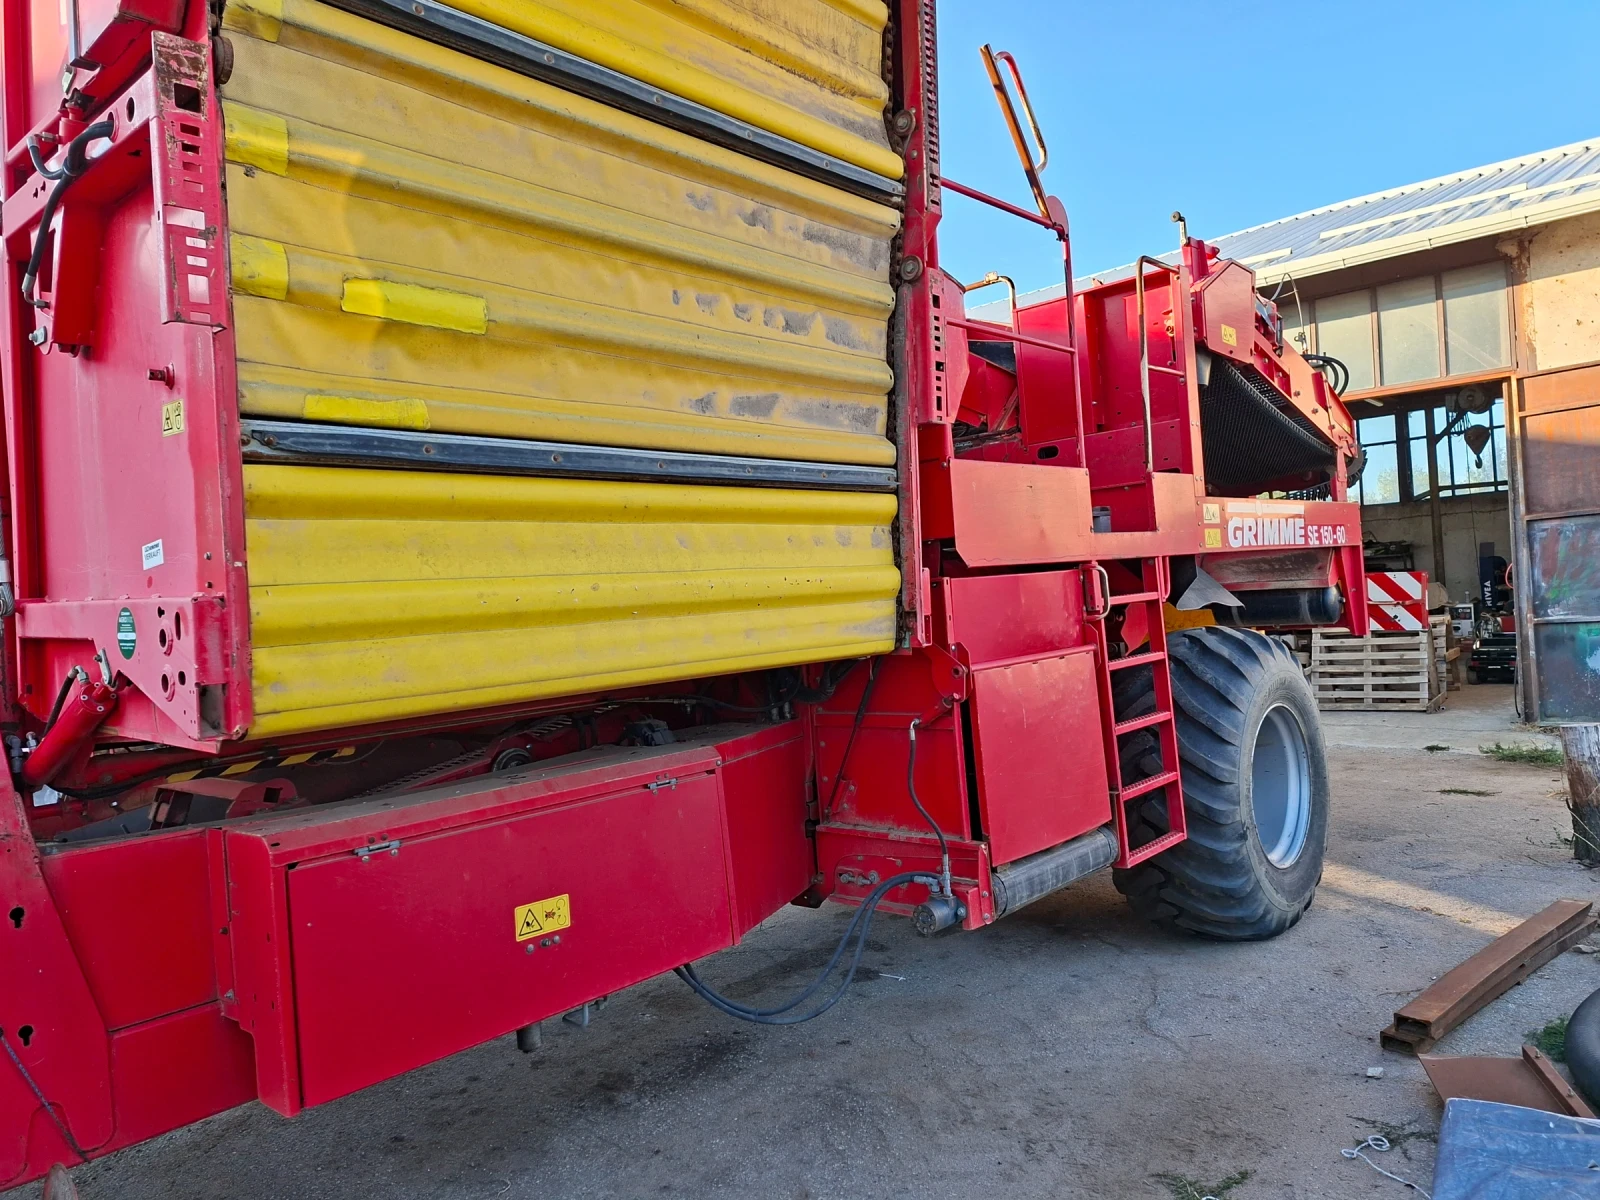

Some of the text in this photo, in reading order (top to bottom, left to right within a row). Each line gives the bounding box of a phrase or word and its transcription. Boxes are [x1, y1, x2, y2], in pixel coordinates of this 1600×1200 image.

[1228, 517, 1345, 548] GRIMME SE 150-60
[1484, 580, 1492, 606] NIVEA
